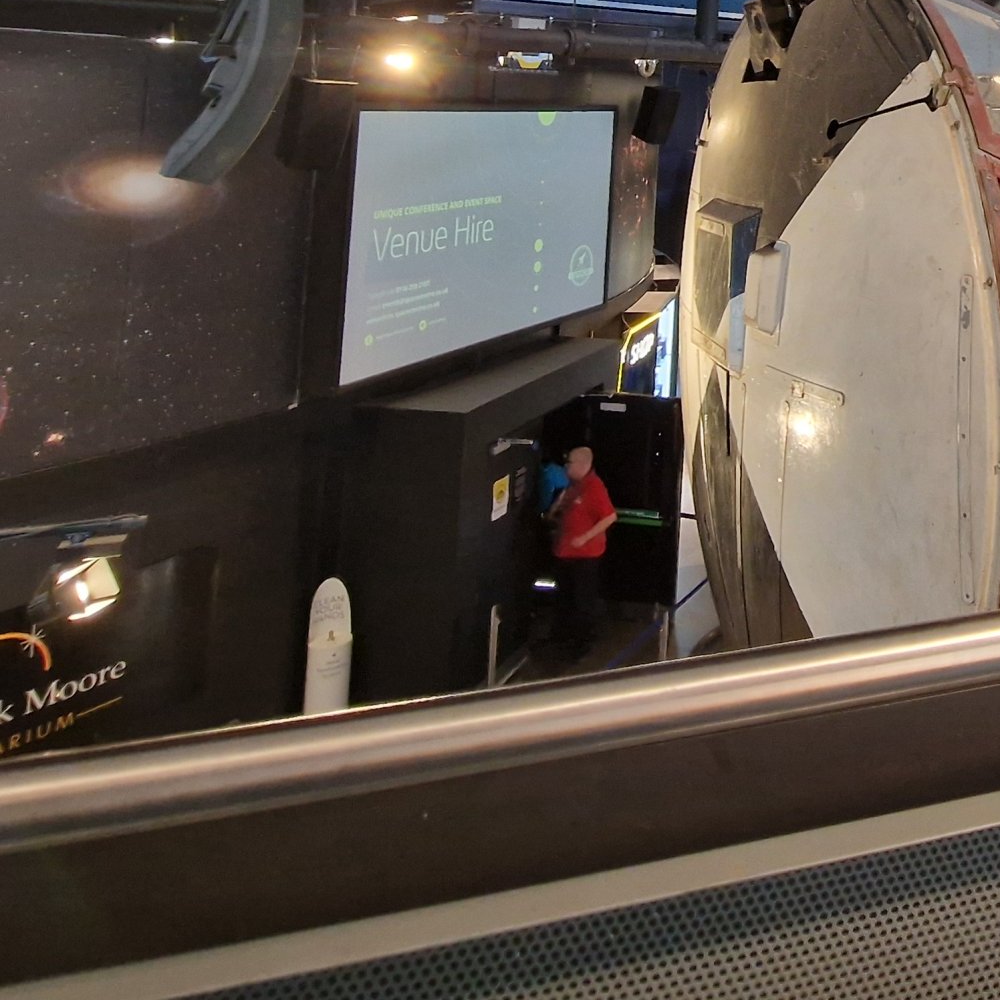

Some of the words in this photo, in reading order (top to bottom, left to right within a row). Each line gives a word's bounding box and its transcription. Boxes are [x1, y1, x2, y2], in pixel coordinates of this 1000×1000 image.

[374, 207, 402, 219] UNIQUE
[404, 202, 448, 215] CONFERENCE
[449, 199, 463, 208] AND
[464, 197, 483, 207] EVENT
[484, 195, 502, 204] SPACE
[373, 226, 447, 261] Venue
[454, 214, 494, 247] Hire
[22, 660, 127, 716] Moore
[0, 712, 75, 753] RIUM
